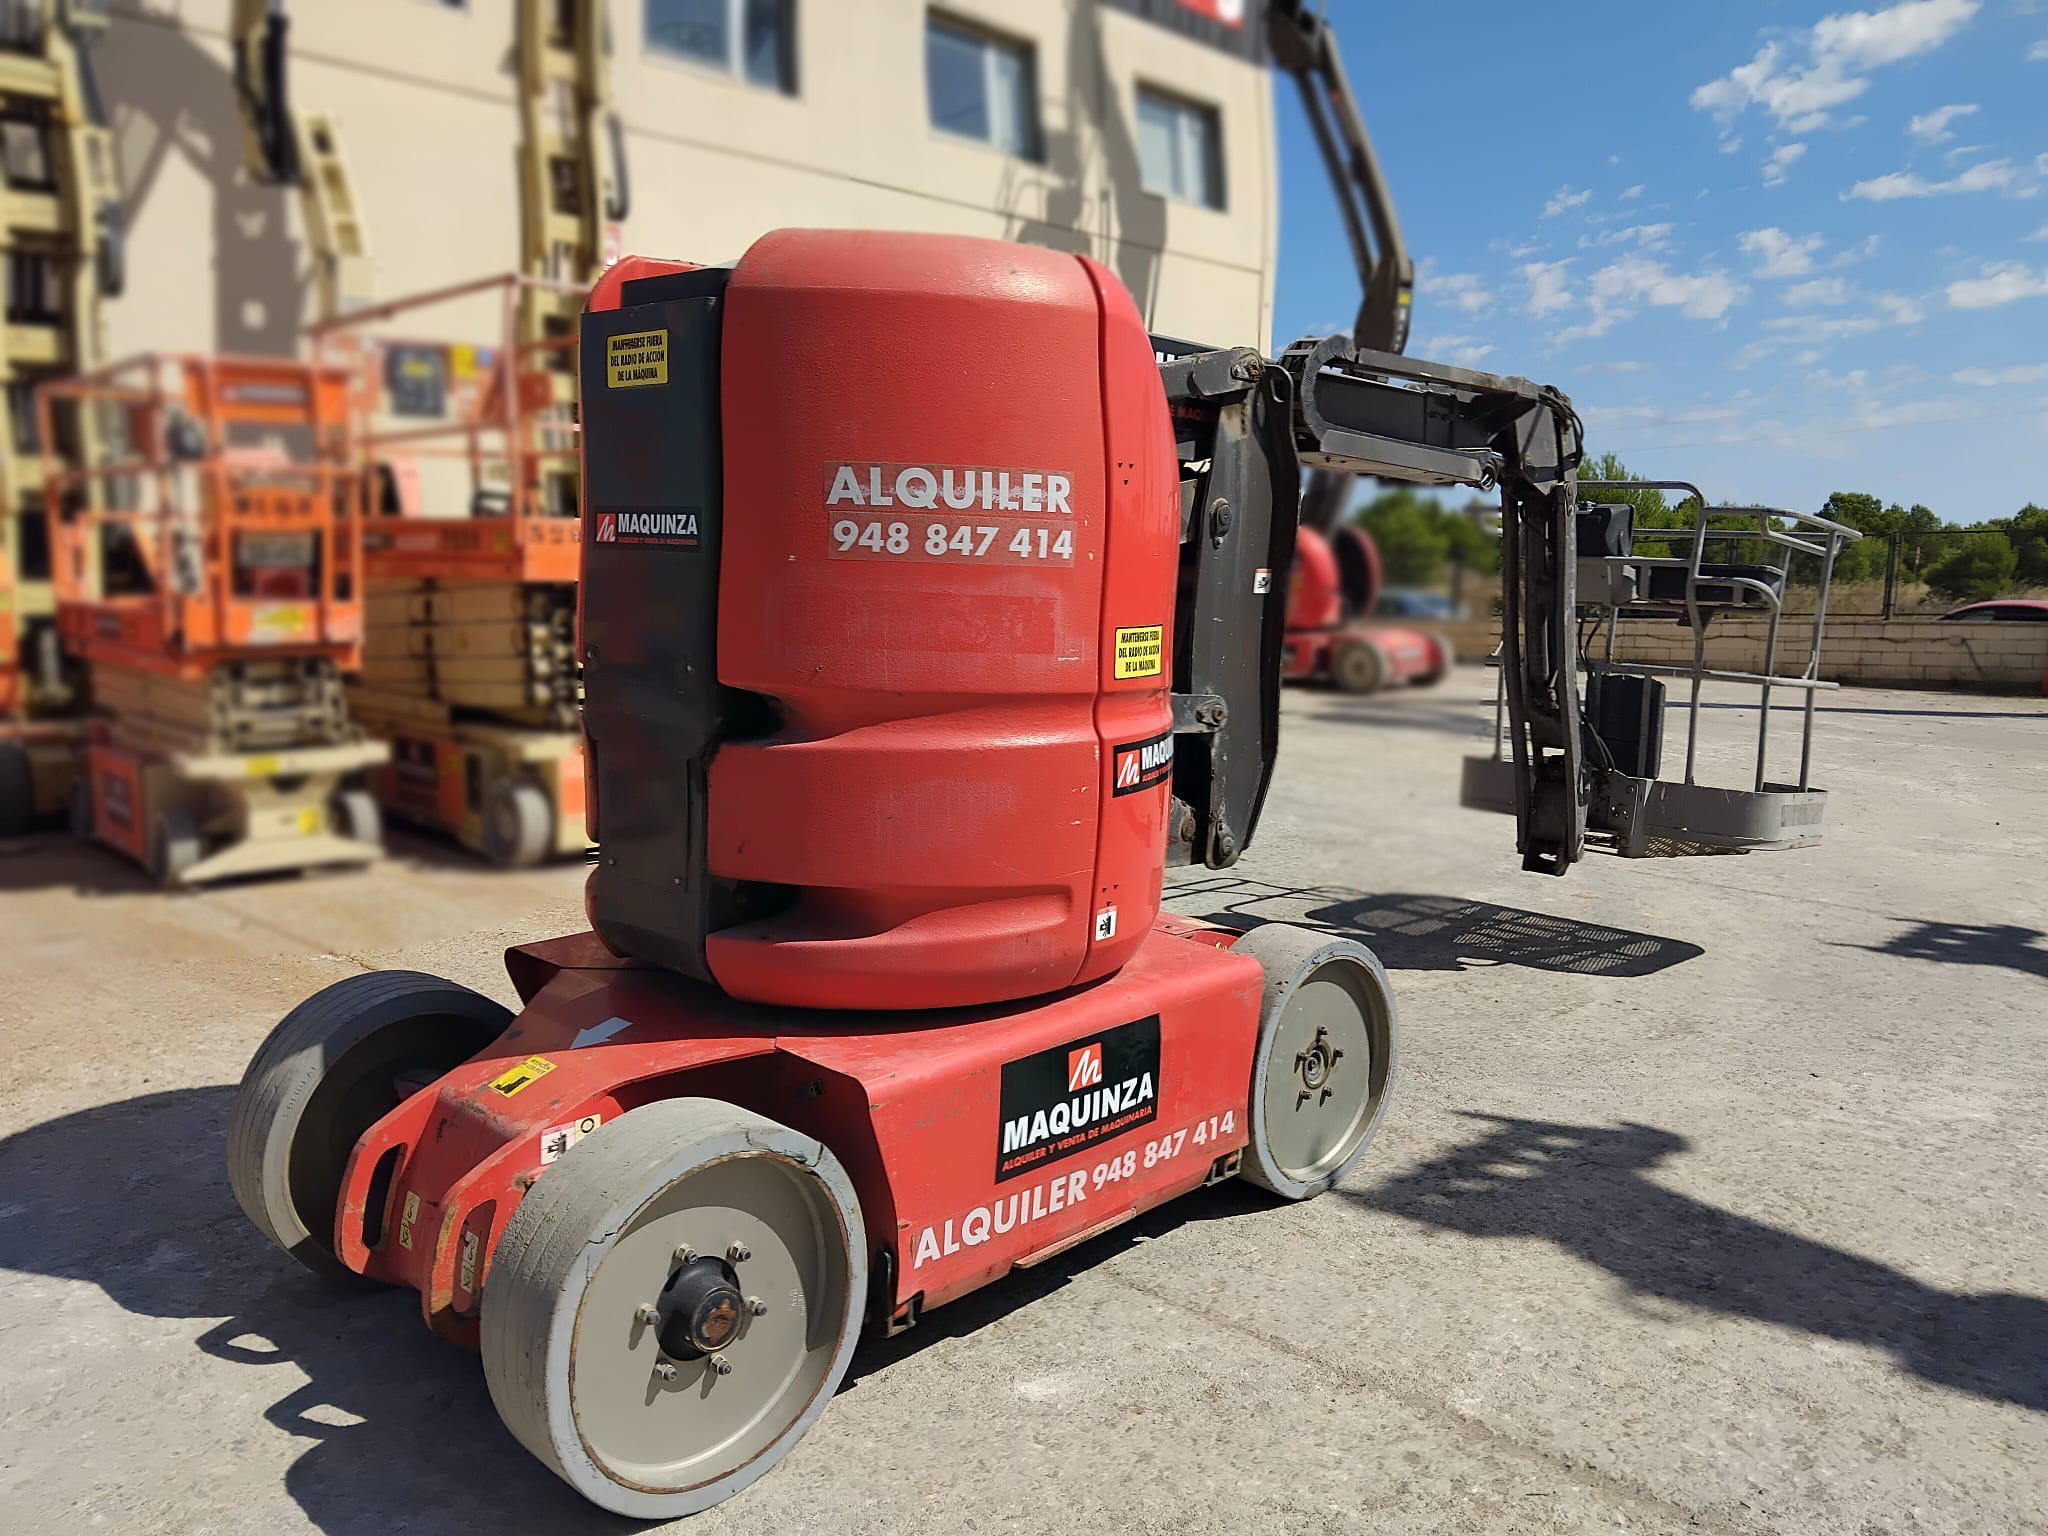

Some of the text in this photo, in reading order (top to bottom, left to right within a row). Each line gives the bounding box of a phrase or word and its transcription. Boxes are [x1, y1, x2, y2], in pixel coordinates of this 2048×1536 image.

[611, 355, 619, 367] DEL
[621, 353, 637, 366] RADIO
[638, 352, 645, 364] DE
[618, 370, 625, 381] DE
[626, 369, 632, 380] LA
[825, 466, 1073, 514] ALQUILER
[618, 513, 698, 535] MAQUINZA
[833, 520, 1073, 559] 948 847 414
[1119, 647, 1127, 658] DEL
[1125, 661, 1131, 672] DE
[1132, 661, 1137, 671] LA
[1002, 1071, 1154, 1154] MAQUINZA
[1002, 1105, 1153, 1172] ALQUILER Y VENTA DE MAQUINARIA
[913, 1109, 1235, 1270] ALQUILER 948 847 414
